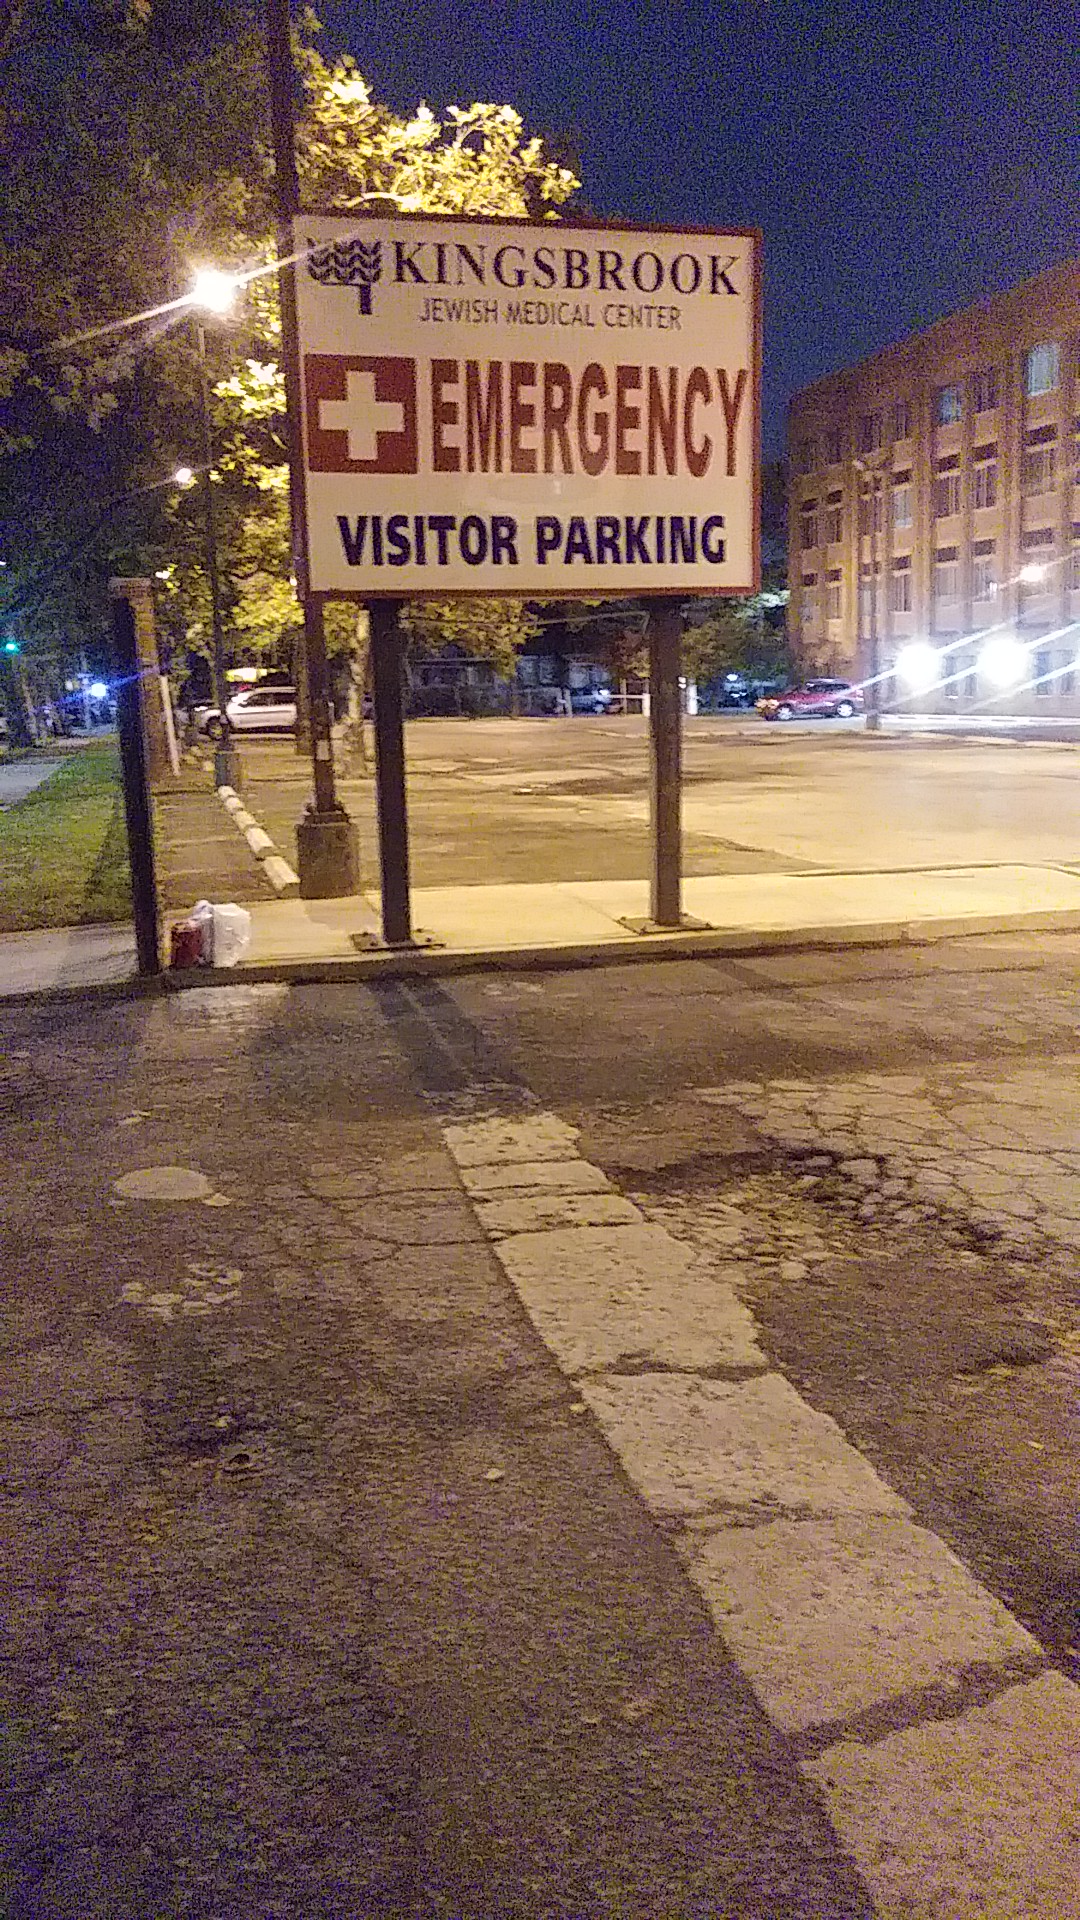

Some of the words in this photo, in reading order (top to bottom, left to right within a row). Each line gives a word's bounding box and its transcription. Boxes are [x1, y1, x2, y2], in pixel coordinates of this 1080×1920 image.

[393, 240, 740, 295] KINGSBROOK
[419, 298, 498, 325] JEWISH
[506, 300, 594, 327] MEDICAL
[604, 303, 682, 331] CENTER
[430, 358, 748, 477] EMERGENCY
[337, 514, 518, 566] VISITOR
[535, 514, 726, 565] PARKING
